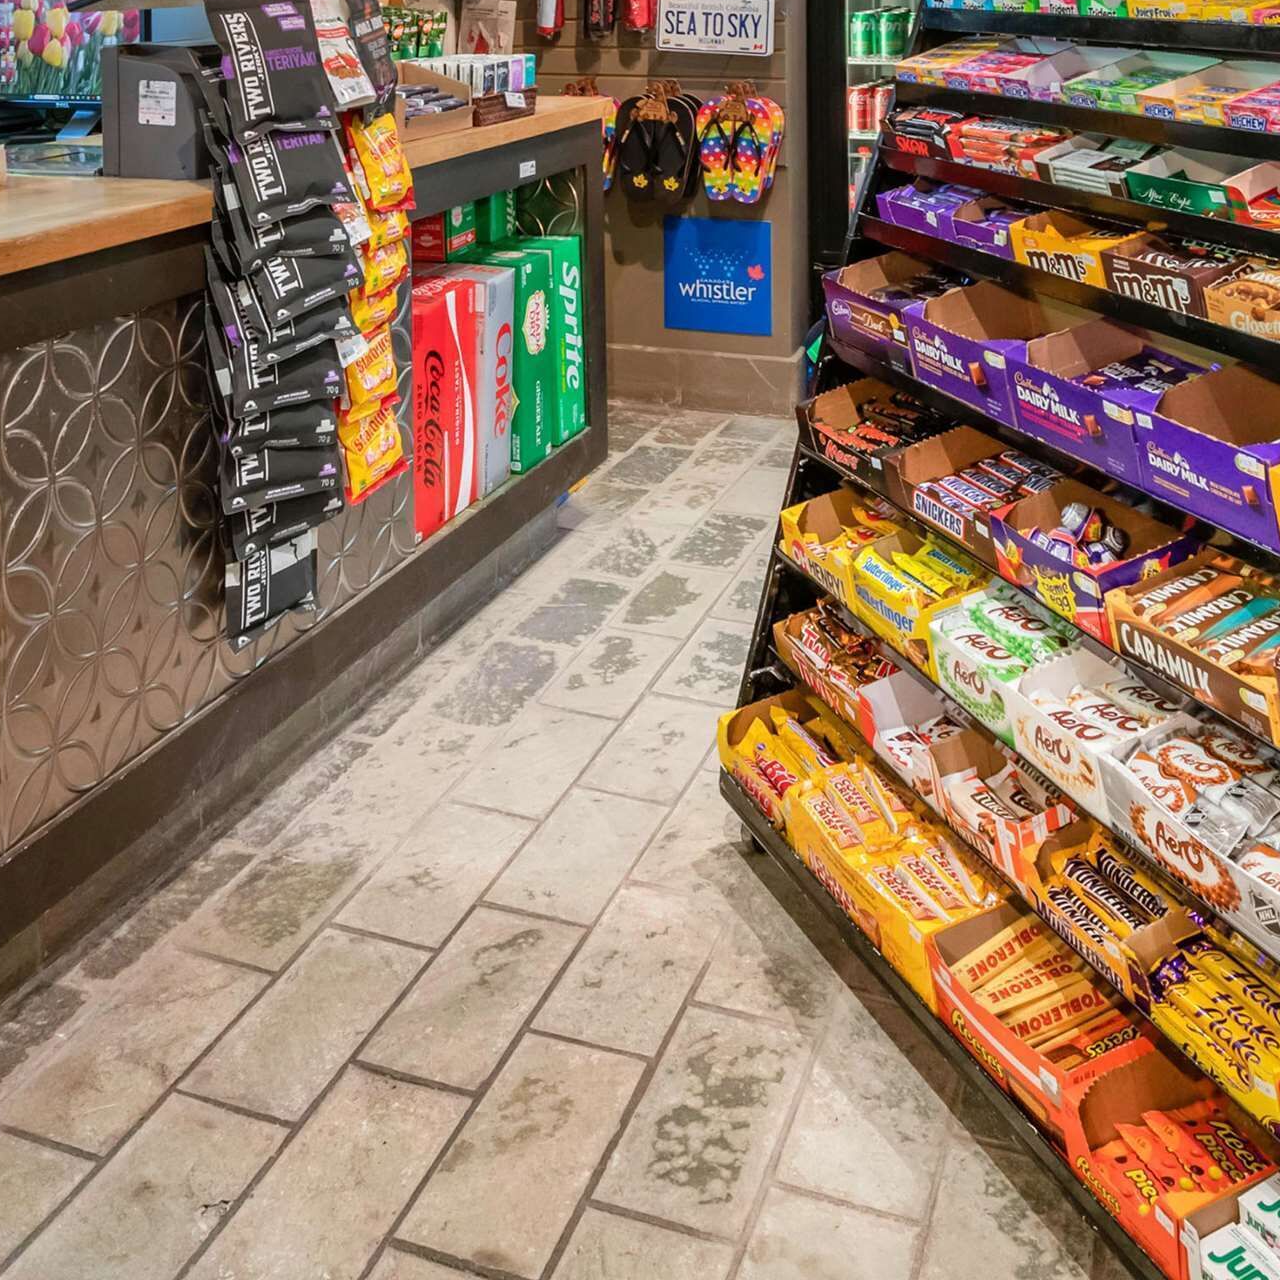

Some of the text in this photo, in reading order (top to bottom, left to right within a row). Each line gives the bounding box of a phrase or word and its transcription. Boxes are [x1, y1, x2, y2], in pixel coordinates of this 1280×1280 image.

[665, 11, 763, 39] SEA TO SKY
[227, 11, 272, 120] TWO RIVERS
[250, 45, 266, 81] JERKY
[268, 51, 317, 71] TERIYAKI
[1144, 104, 1175, 118] HI-CHEW
[1230, 114, 1265, 130] HI-CHEW
[896, 136, 929, 156] SKOR
[1026, 249, 1087, 282] m&m's
[678, 279, 757, 302] whistler
[559, 261, 580, 391] Sprite
[914, 340, 965, 376] DAIRY MILK
[495, 322, 511, 437] Coke
[914, 493, 963, 535] SNICKERS
[809, 558, 848, 606] HENRY!
[862, 556, 908, 593] Butterfinger
[1049, 594, 1072, 612] egg
[956, 633, 1012, 660] Aero
[1121, 622, 1212, 694] CARAMILK
[833, 780, 859, 808] CRISP
